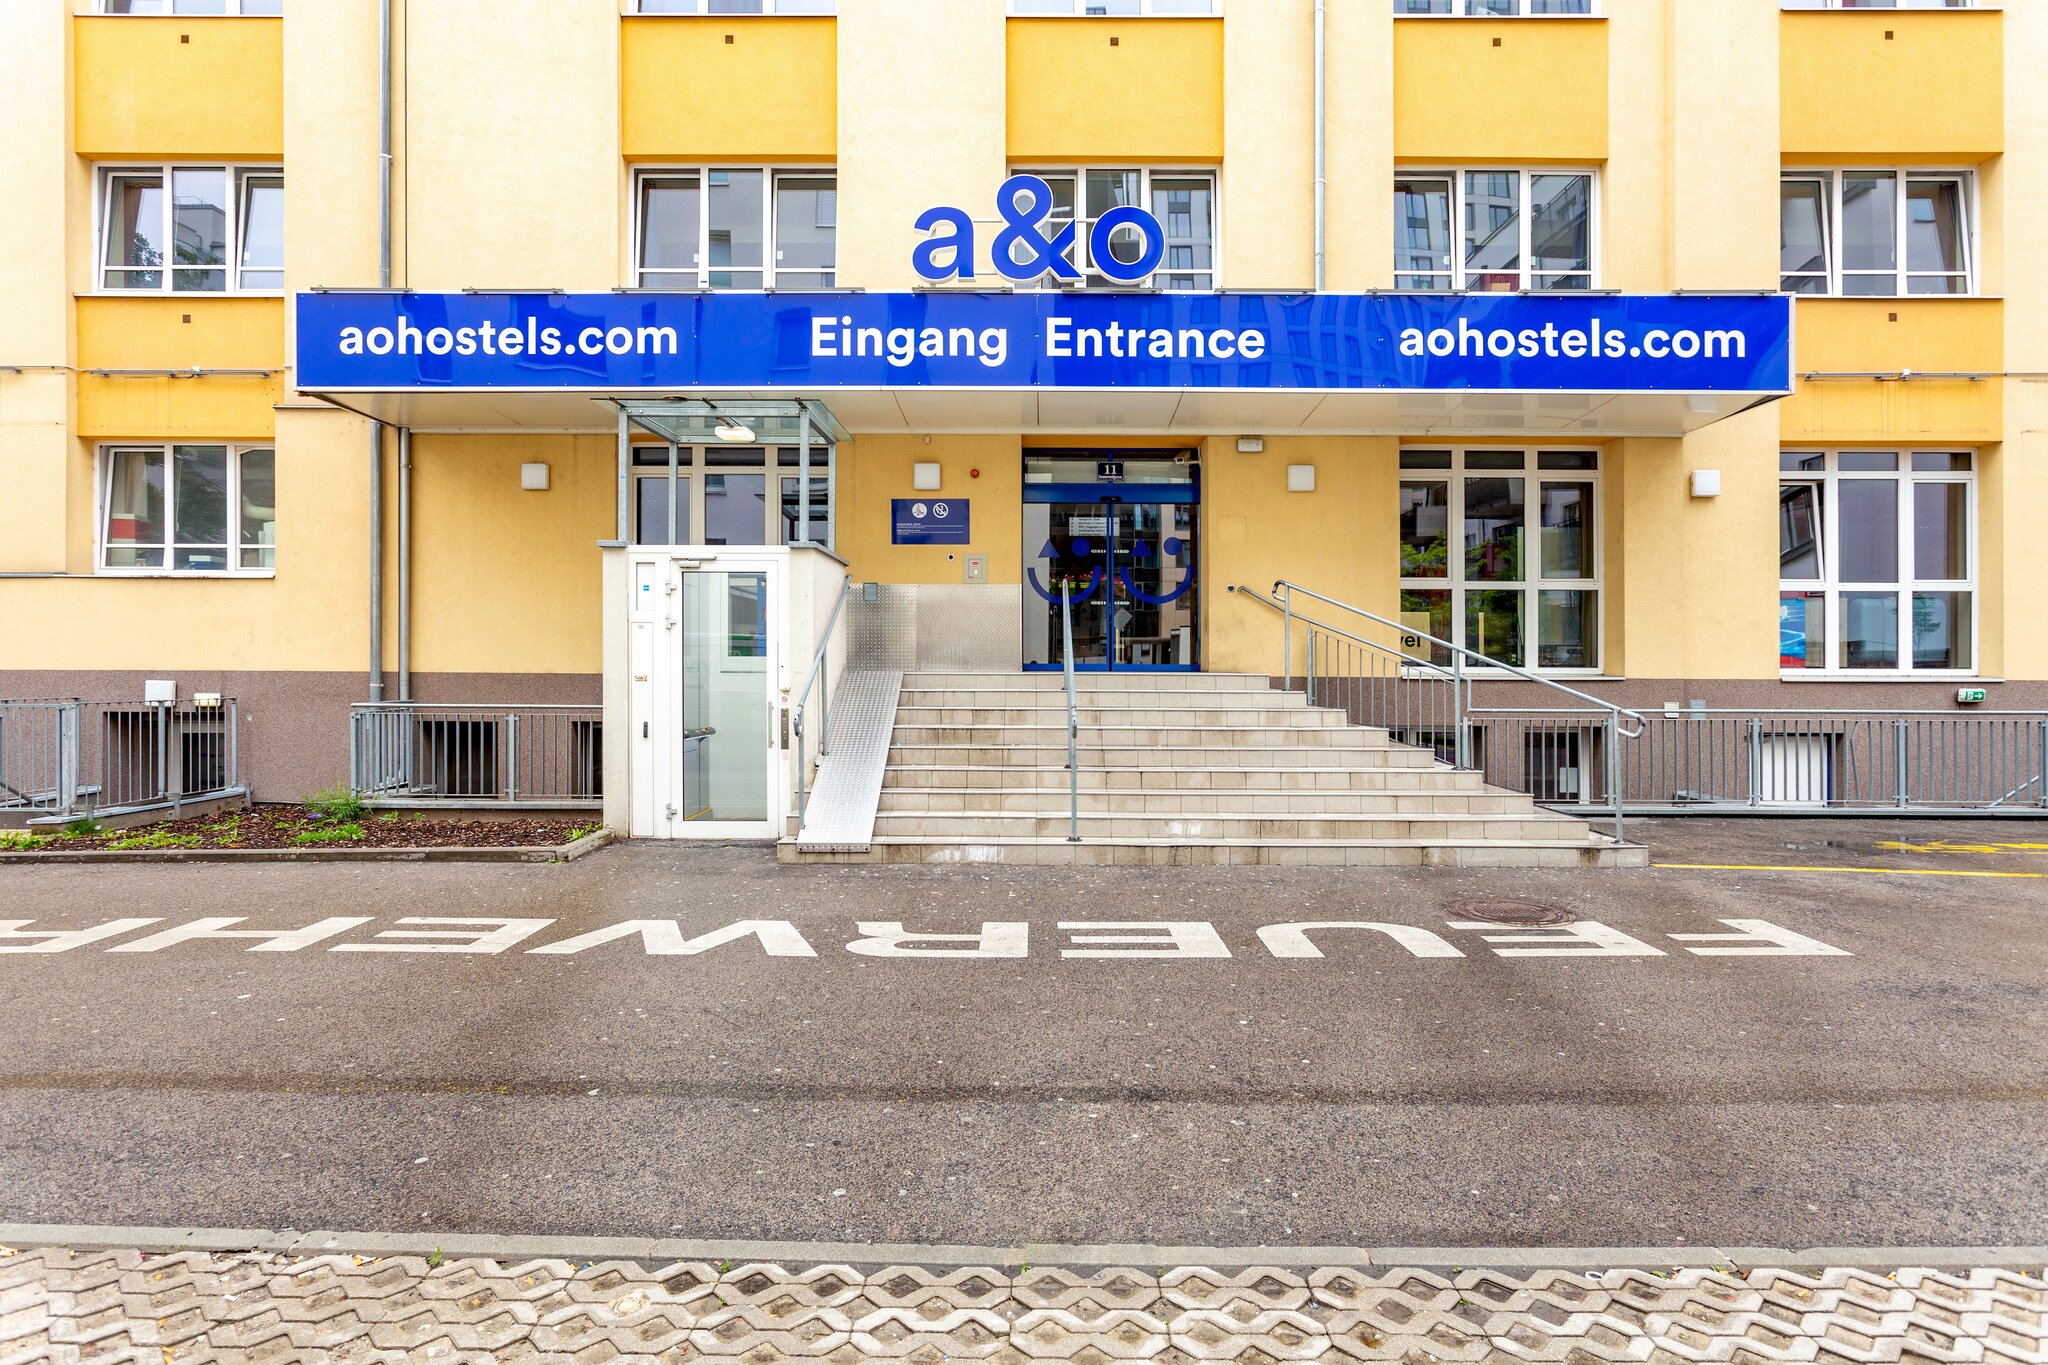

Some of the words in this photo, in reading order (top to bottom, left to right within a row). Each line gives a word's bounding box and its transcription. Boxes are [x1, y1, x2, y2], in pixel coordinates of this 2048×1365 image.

[911, 174, 1166, 284] a&o
[339, 315, 678, 356] aohostels.com
[811, 315, 1007, 368] Eingang
[1046, 316, 1265, 359] Entrance
[1399, 317, 1746, 359] aohostels.com
[1104, 464, 1117, 475] 11
